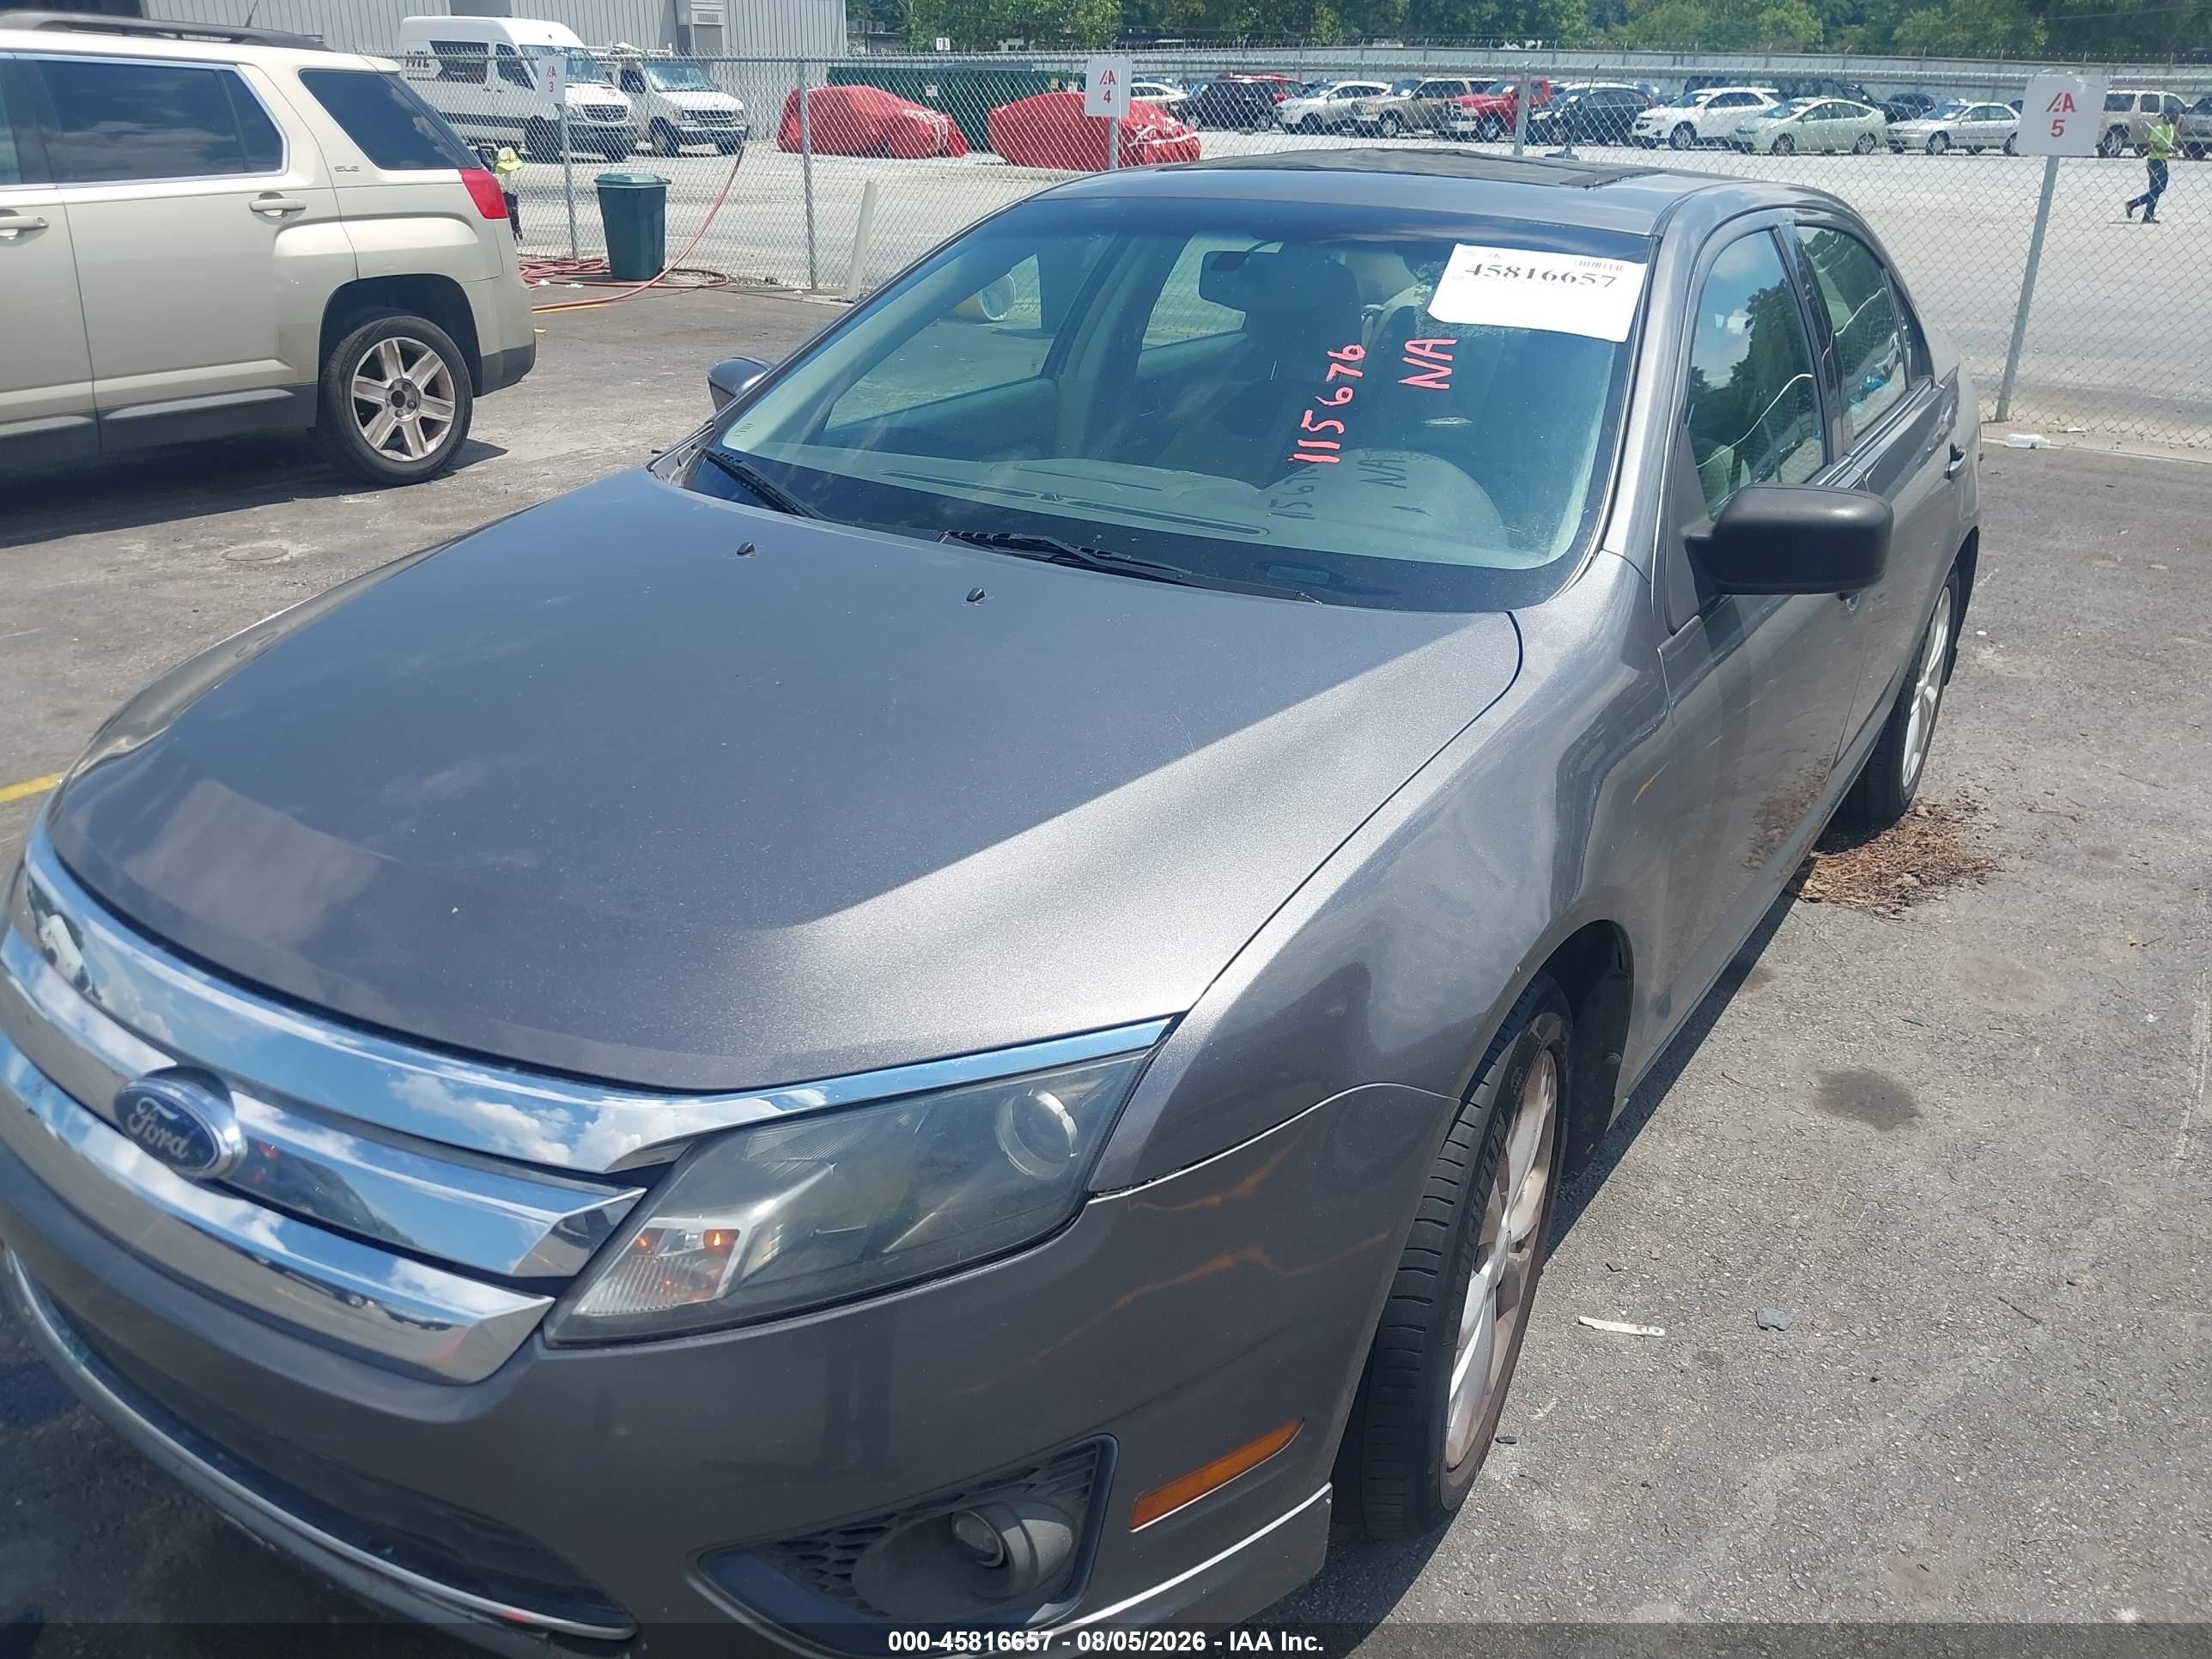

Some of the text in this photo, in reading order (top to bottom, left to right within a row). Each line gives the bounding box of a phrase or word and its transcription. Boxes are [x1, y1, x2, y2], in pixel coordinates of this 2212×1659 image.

[549, 81, 554, 93] 3
[1103, 89, 1112, 104] 4
[2051, 118, 2066, 138] 5
[1465, 263, 1618, 289] 45816657
[1286, 343, 1367, 465] 115676
[128, 1097, 191, 1159] Ford
